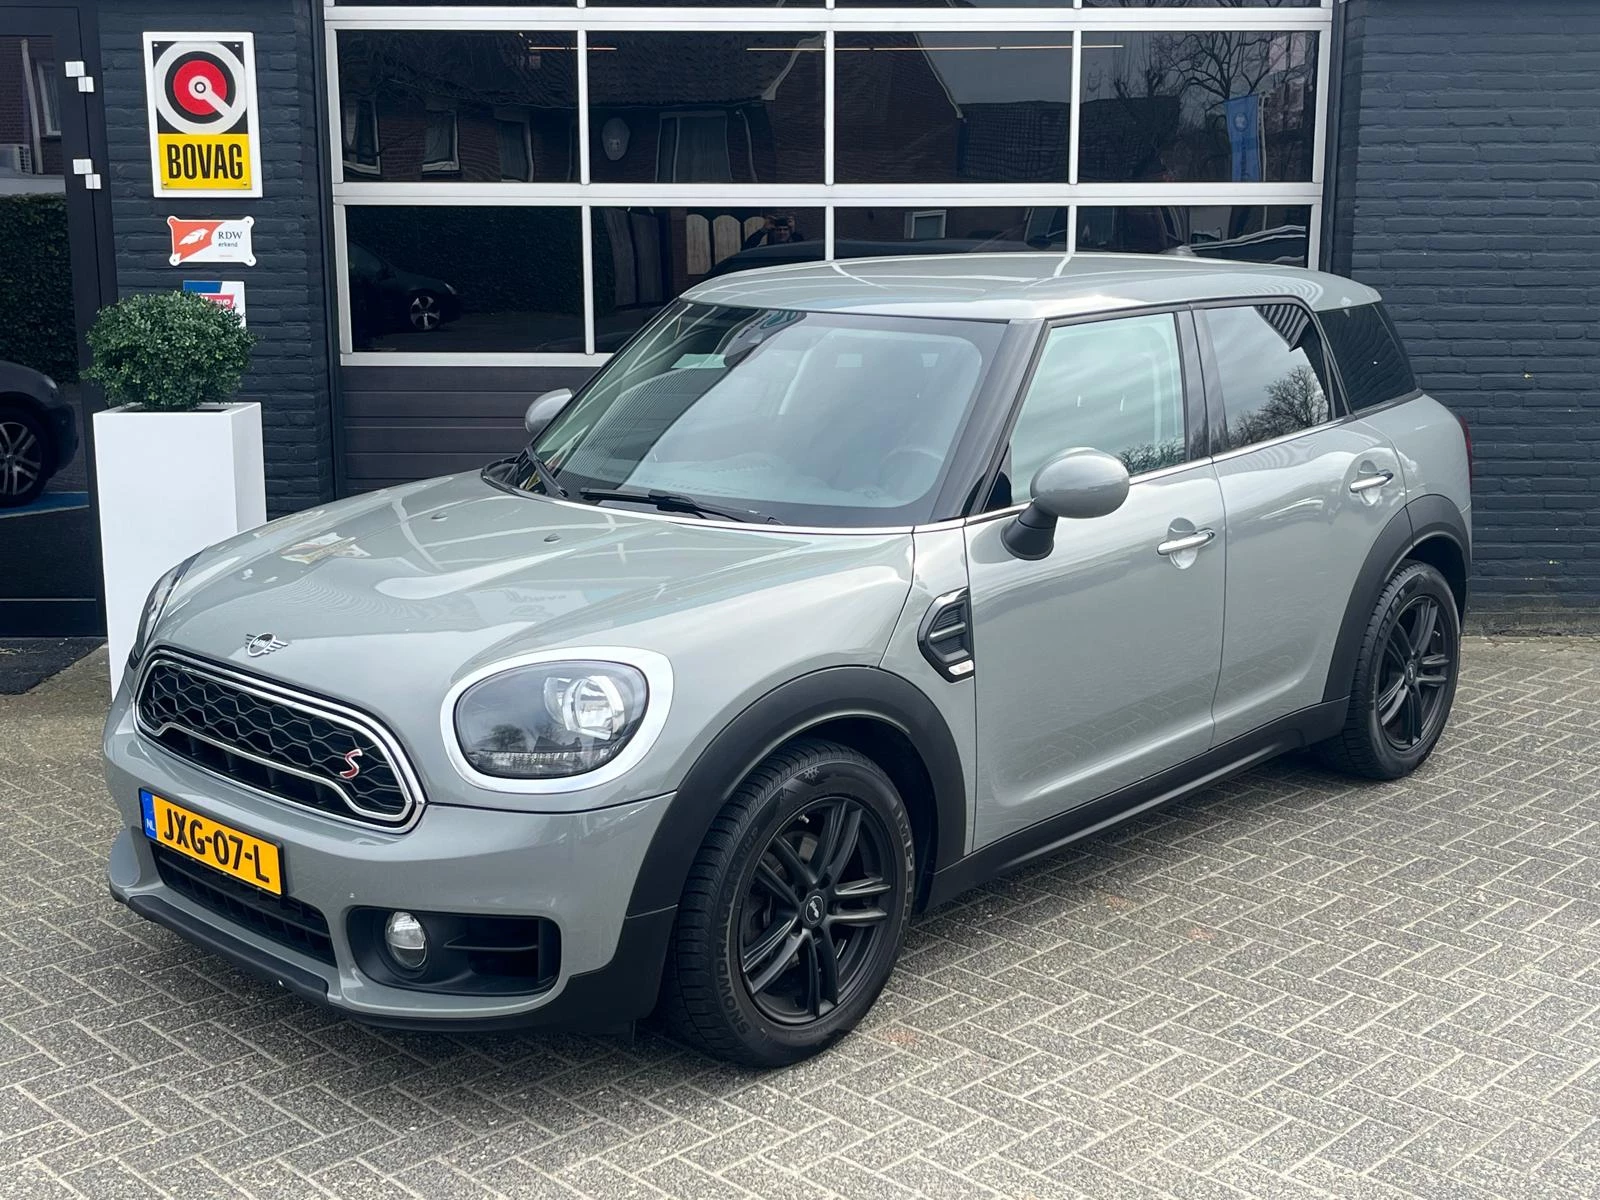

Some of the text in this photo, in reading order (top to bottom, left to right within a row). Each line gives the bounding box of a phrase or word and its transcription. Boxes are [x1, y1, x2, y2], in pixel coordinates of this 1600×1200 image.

[167, 143, 243, 180] BOVAG
[218, 232, 243, 241] RDW
[340, 748, 362, 779] S
[146, 818, 155, 831] NL
[164, 808, 269, 883] JXG-07-L
